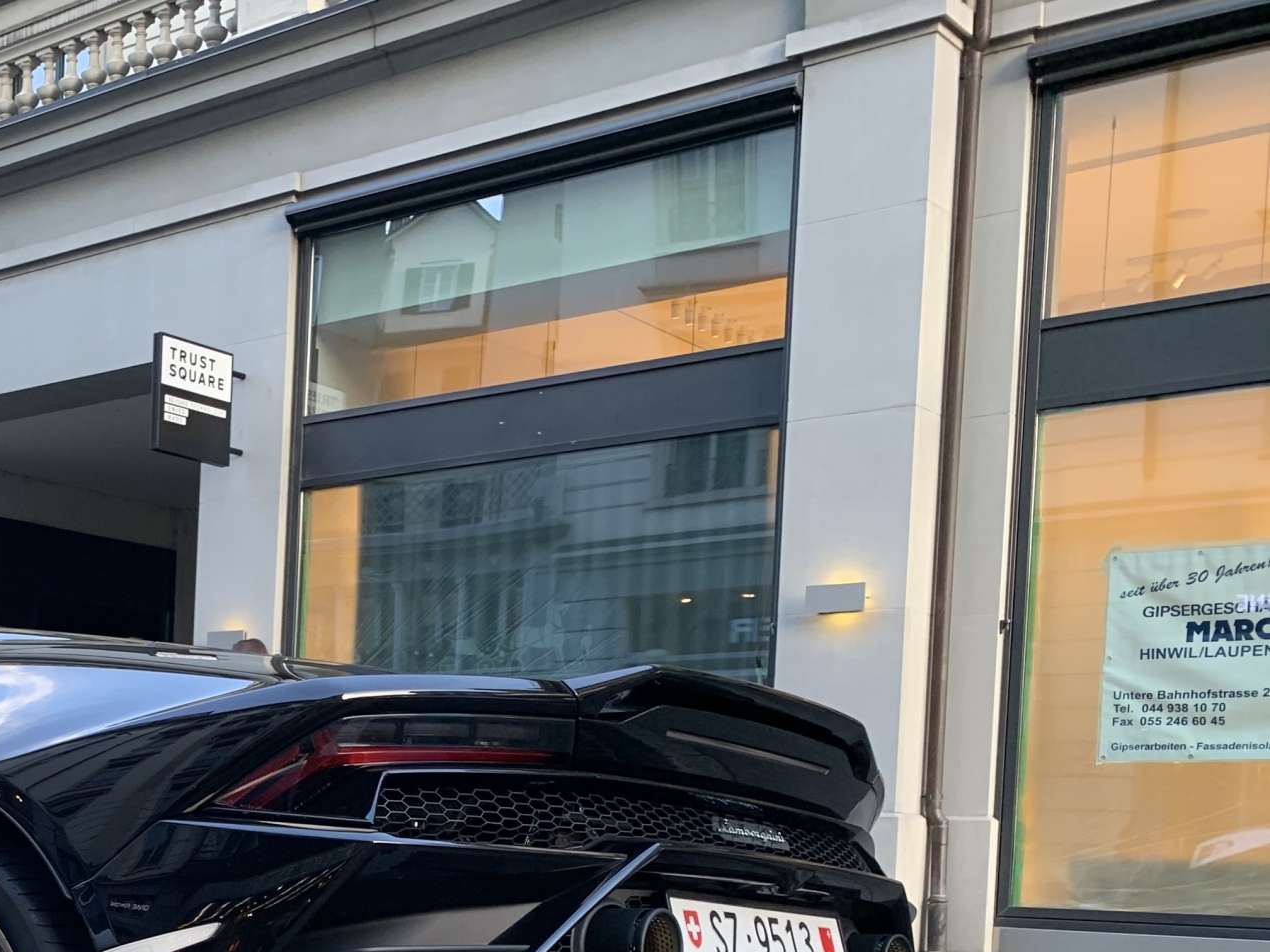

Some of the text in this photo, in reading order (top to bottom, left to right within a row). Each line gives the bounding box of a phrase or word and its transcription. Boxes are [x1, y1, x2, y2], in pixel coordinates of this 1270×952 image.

[170, 347, 216, 371] TRUST
[168, 363, 225, 391] SQUARE
[1119, 585, 1146, 599] seit
[1150, 577, 1181, 593] über
[1186, 569, 1209, 585] 30
[1113, 690, 1154, 701] Untere
[1157, 688, 1259, 700] Bahnhofstrasse
[1113, 702, 1226, 714] Tel. 044 938 10 70
[1112, 716, 1226, 727] Fax 055 246 60 45
[1110, 742, 1187, 752] Gipserarbeiten
[1196, 741, 1270, 751] Fassadenisol
